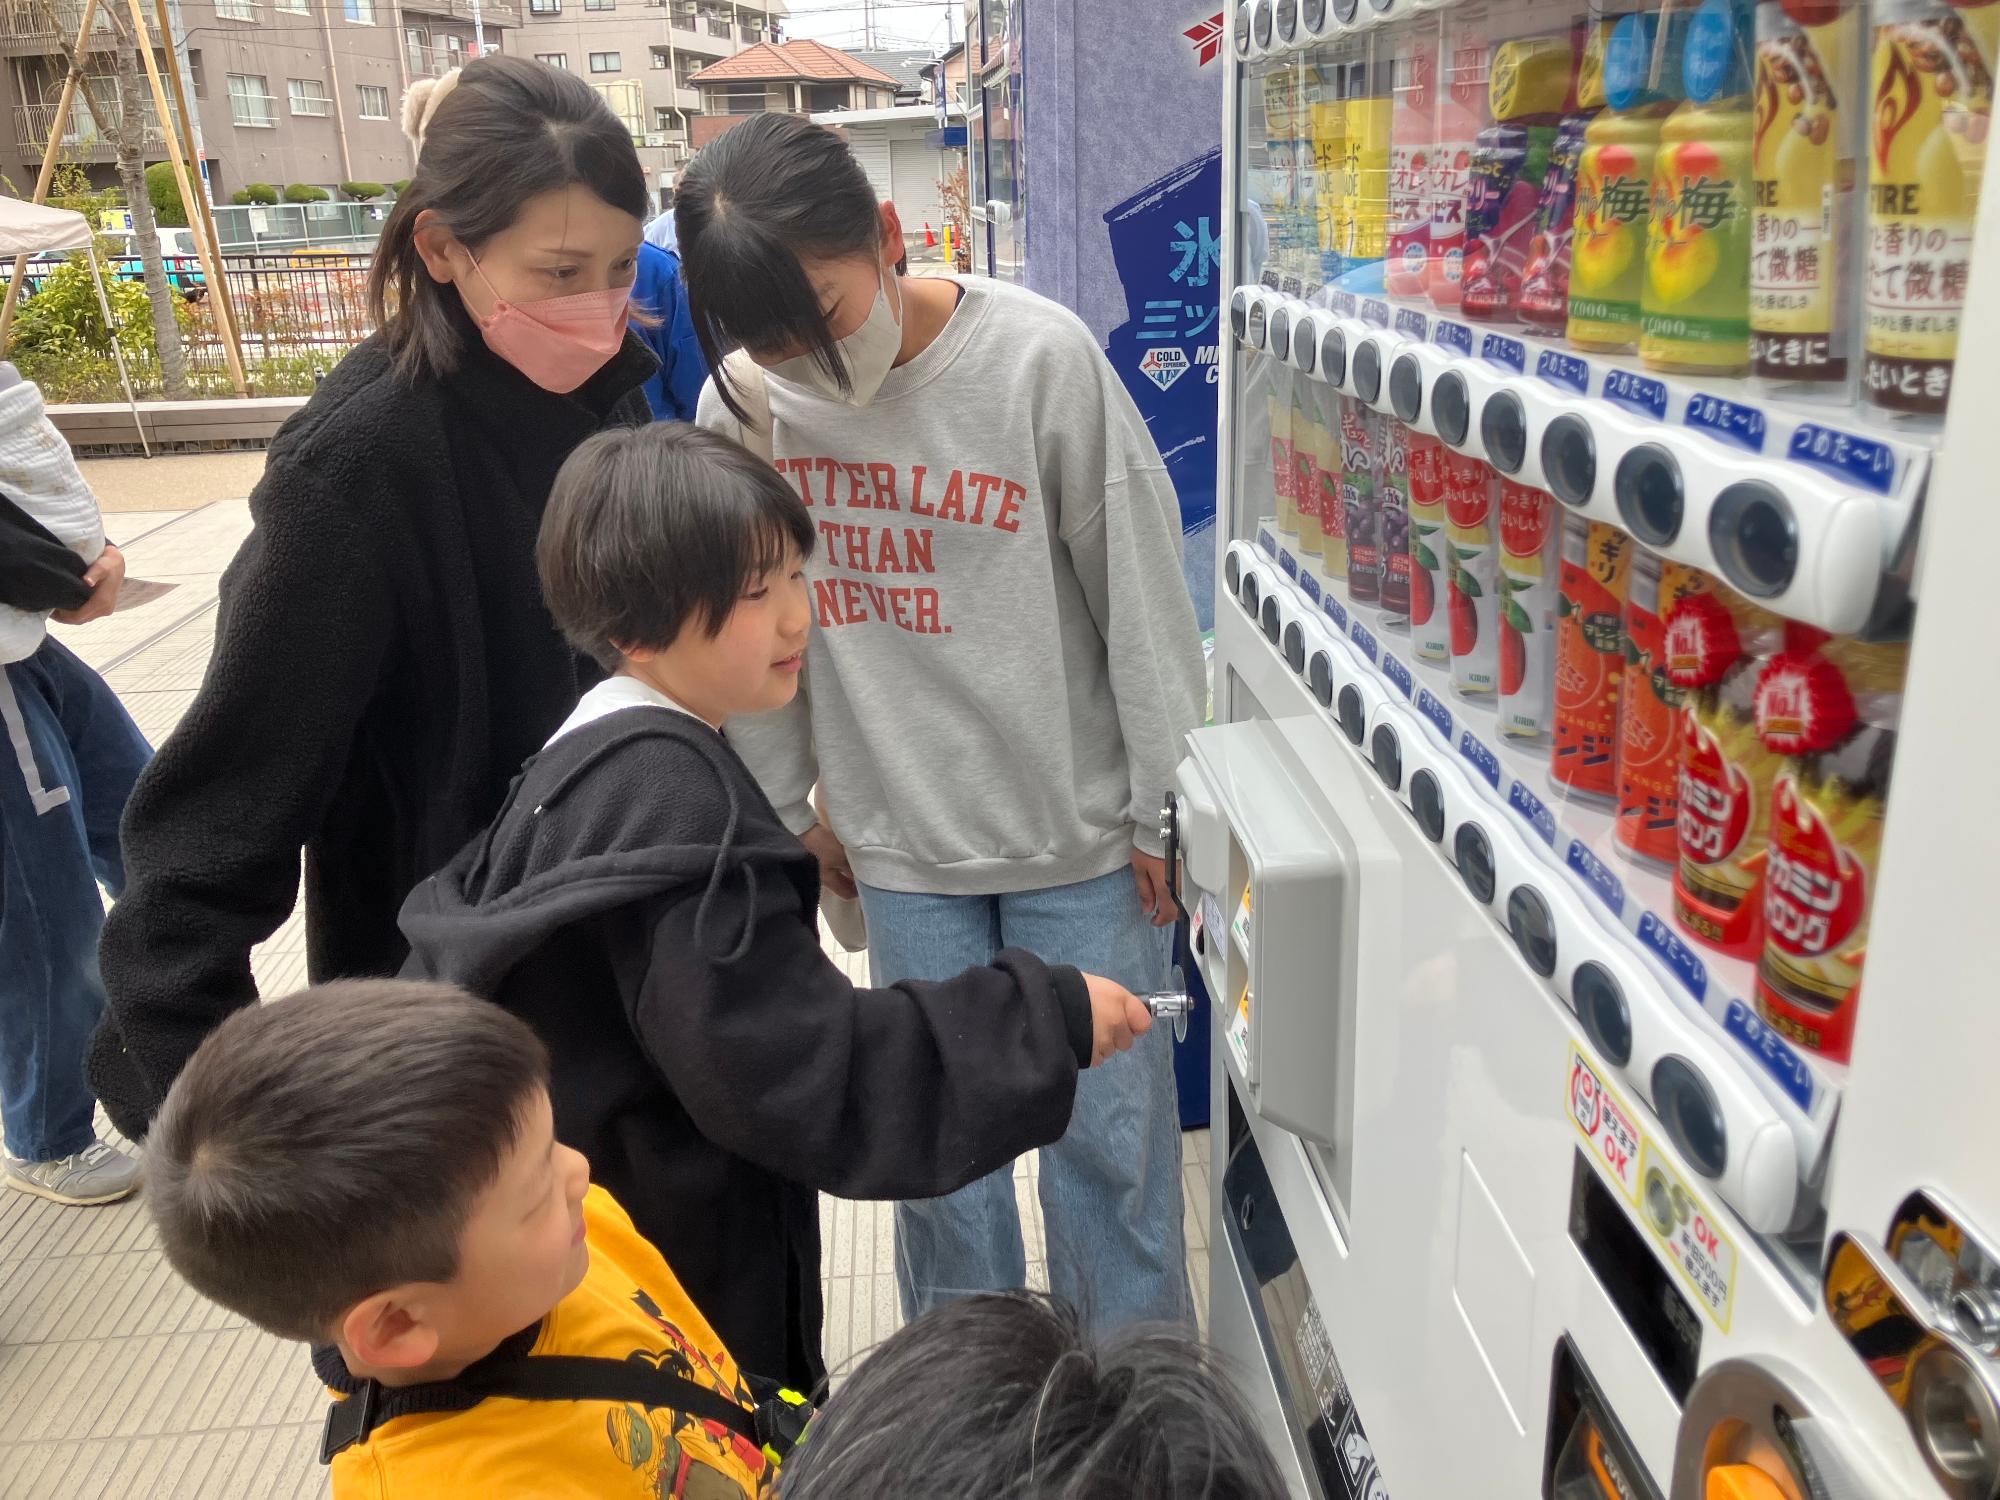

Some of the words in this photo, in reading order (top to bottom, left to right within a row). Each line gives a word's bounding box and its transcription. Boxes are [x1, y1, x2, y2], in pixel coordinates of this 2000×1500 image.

[1157, 352, 1180, 361] COLD
[910, 465, 1027, 533] LATE
[819, 520, 936, 573] THAN
[813, 579, 952, 634] NEVER.
[1468, 673, 1490, 684] KIRIN
[1513, 714, 1536, 728] KIRIN
[1605, 1135, 1628, 1181] OK
[1695, 1216, 1719, 1261] OK
